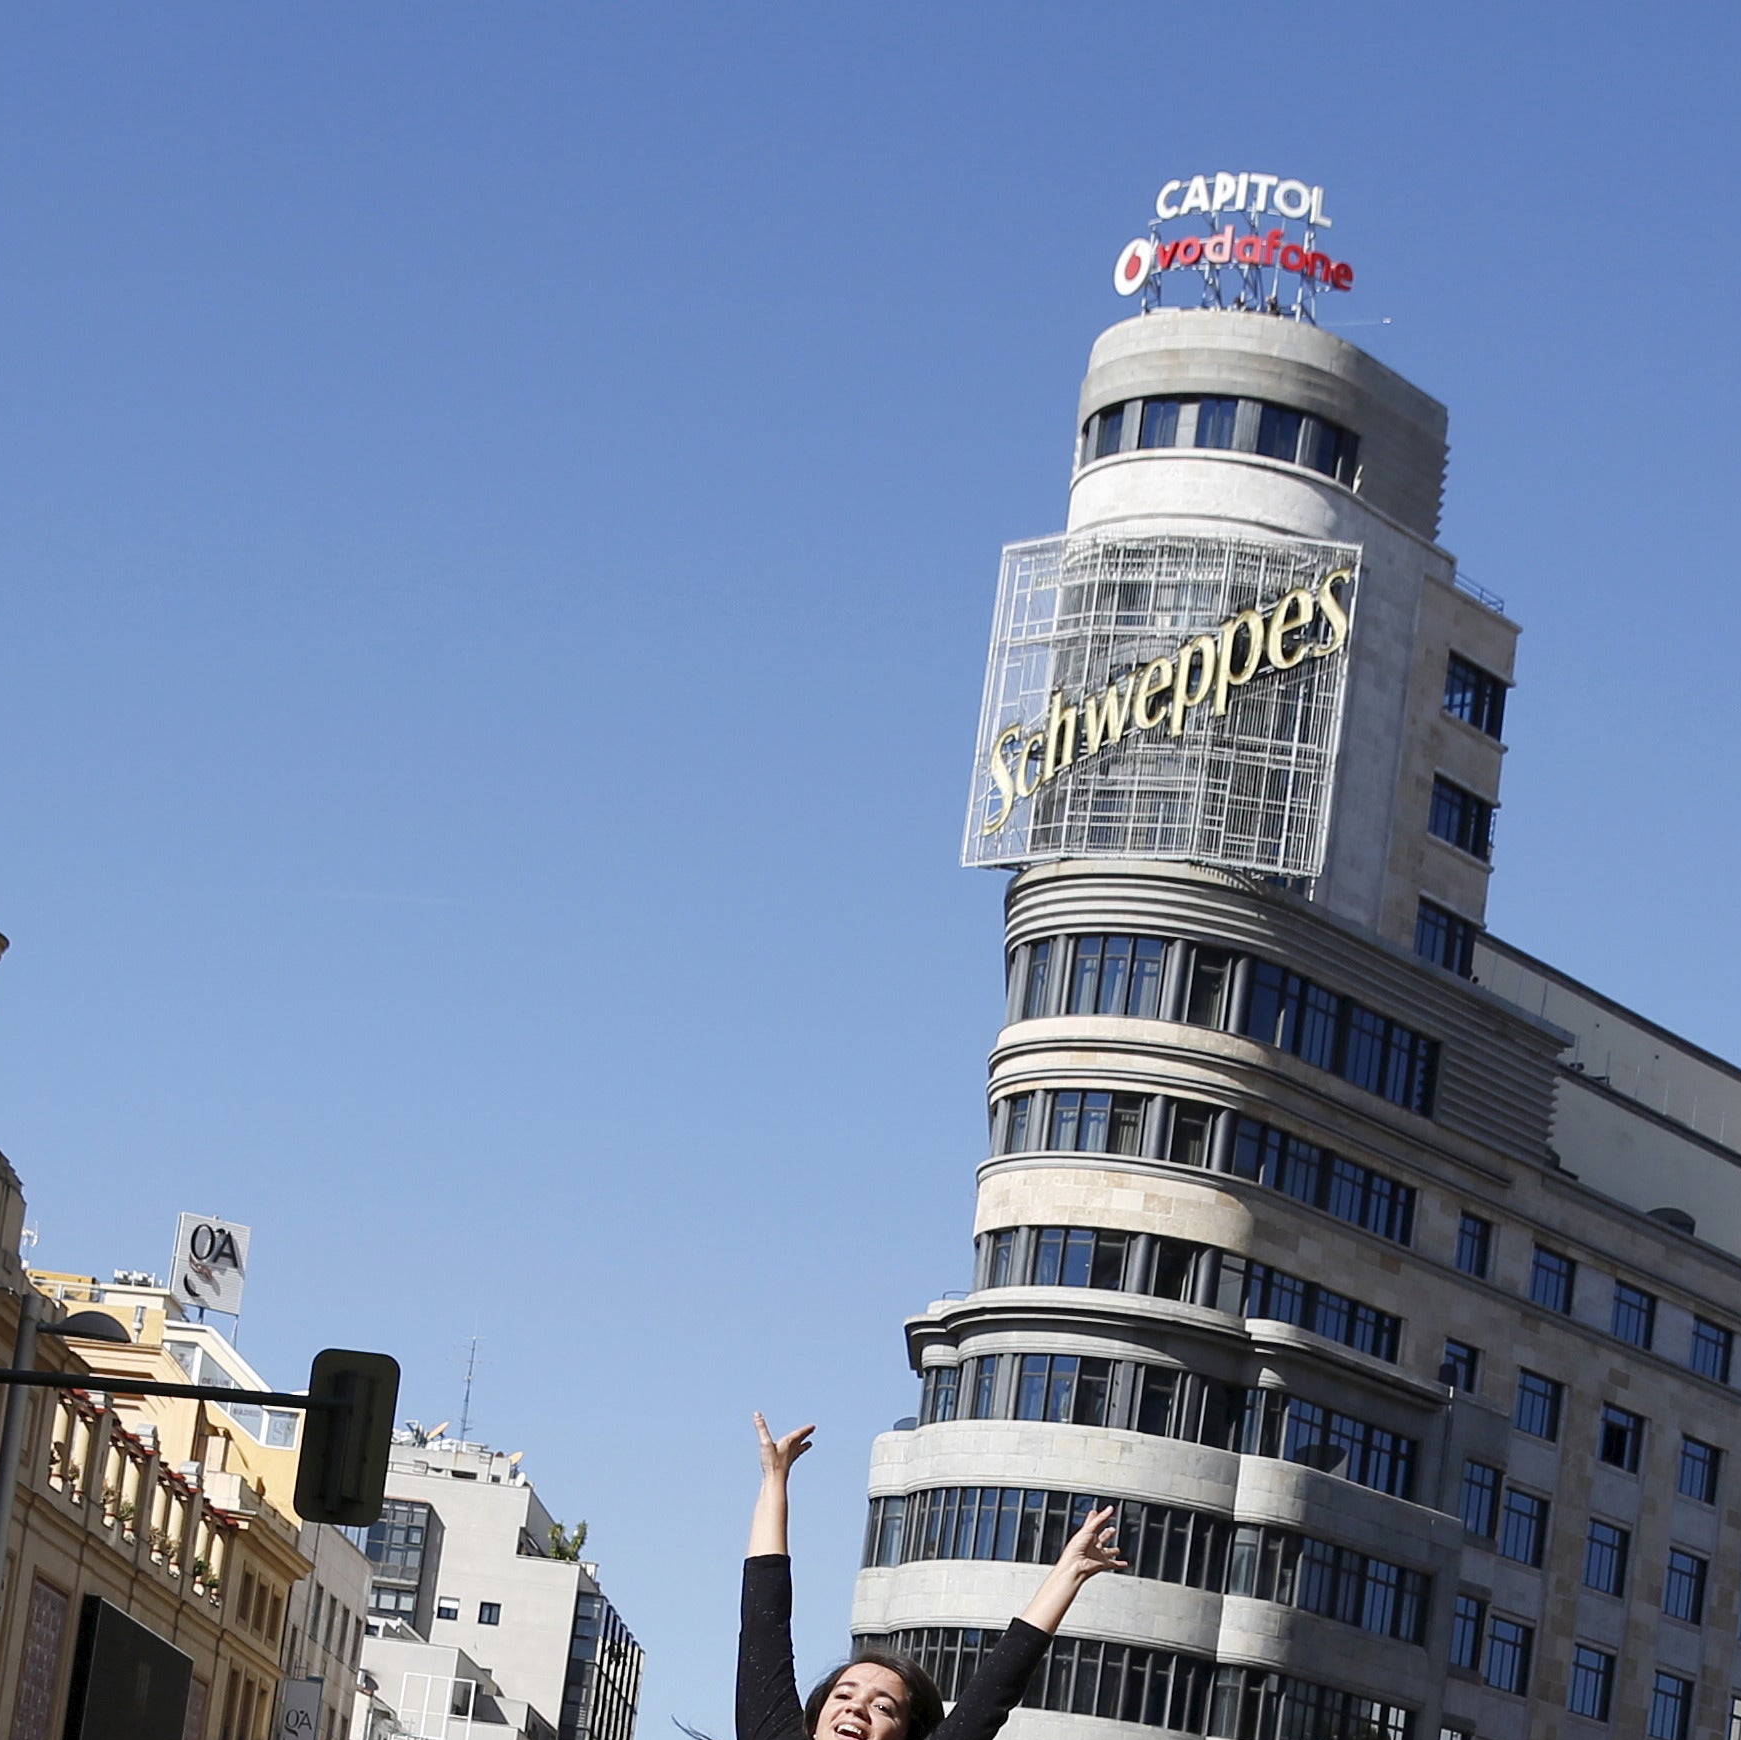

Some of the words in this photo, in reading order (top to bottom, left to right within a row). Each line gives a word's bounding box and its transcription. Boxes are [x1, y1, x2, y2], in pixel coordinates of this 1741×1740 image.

[1155, 171, 1332, 229] CAPITOL
[1156, 224, 1354, 291] vodafone
[981, 568, 1352, 836] Schweppes
